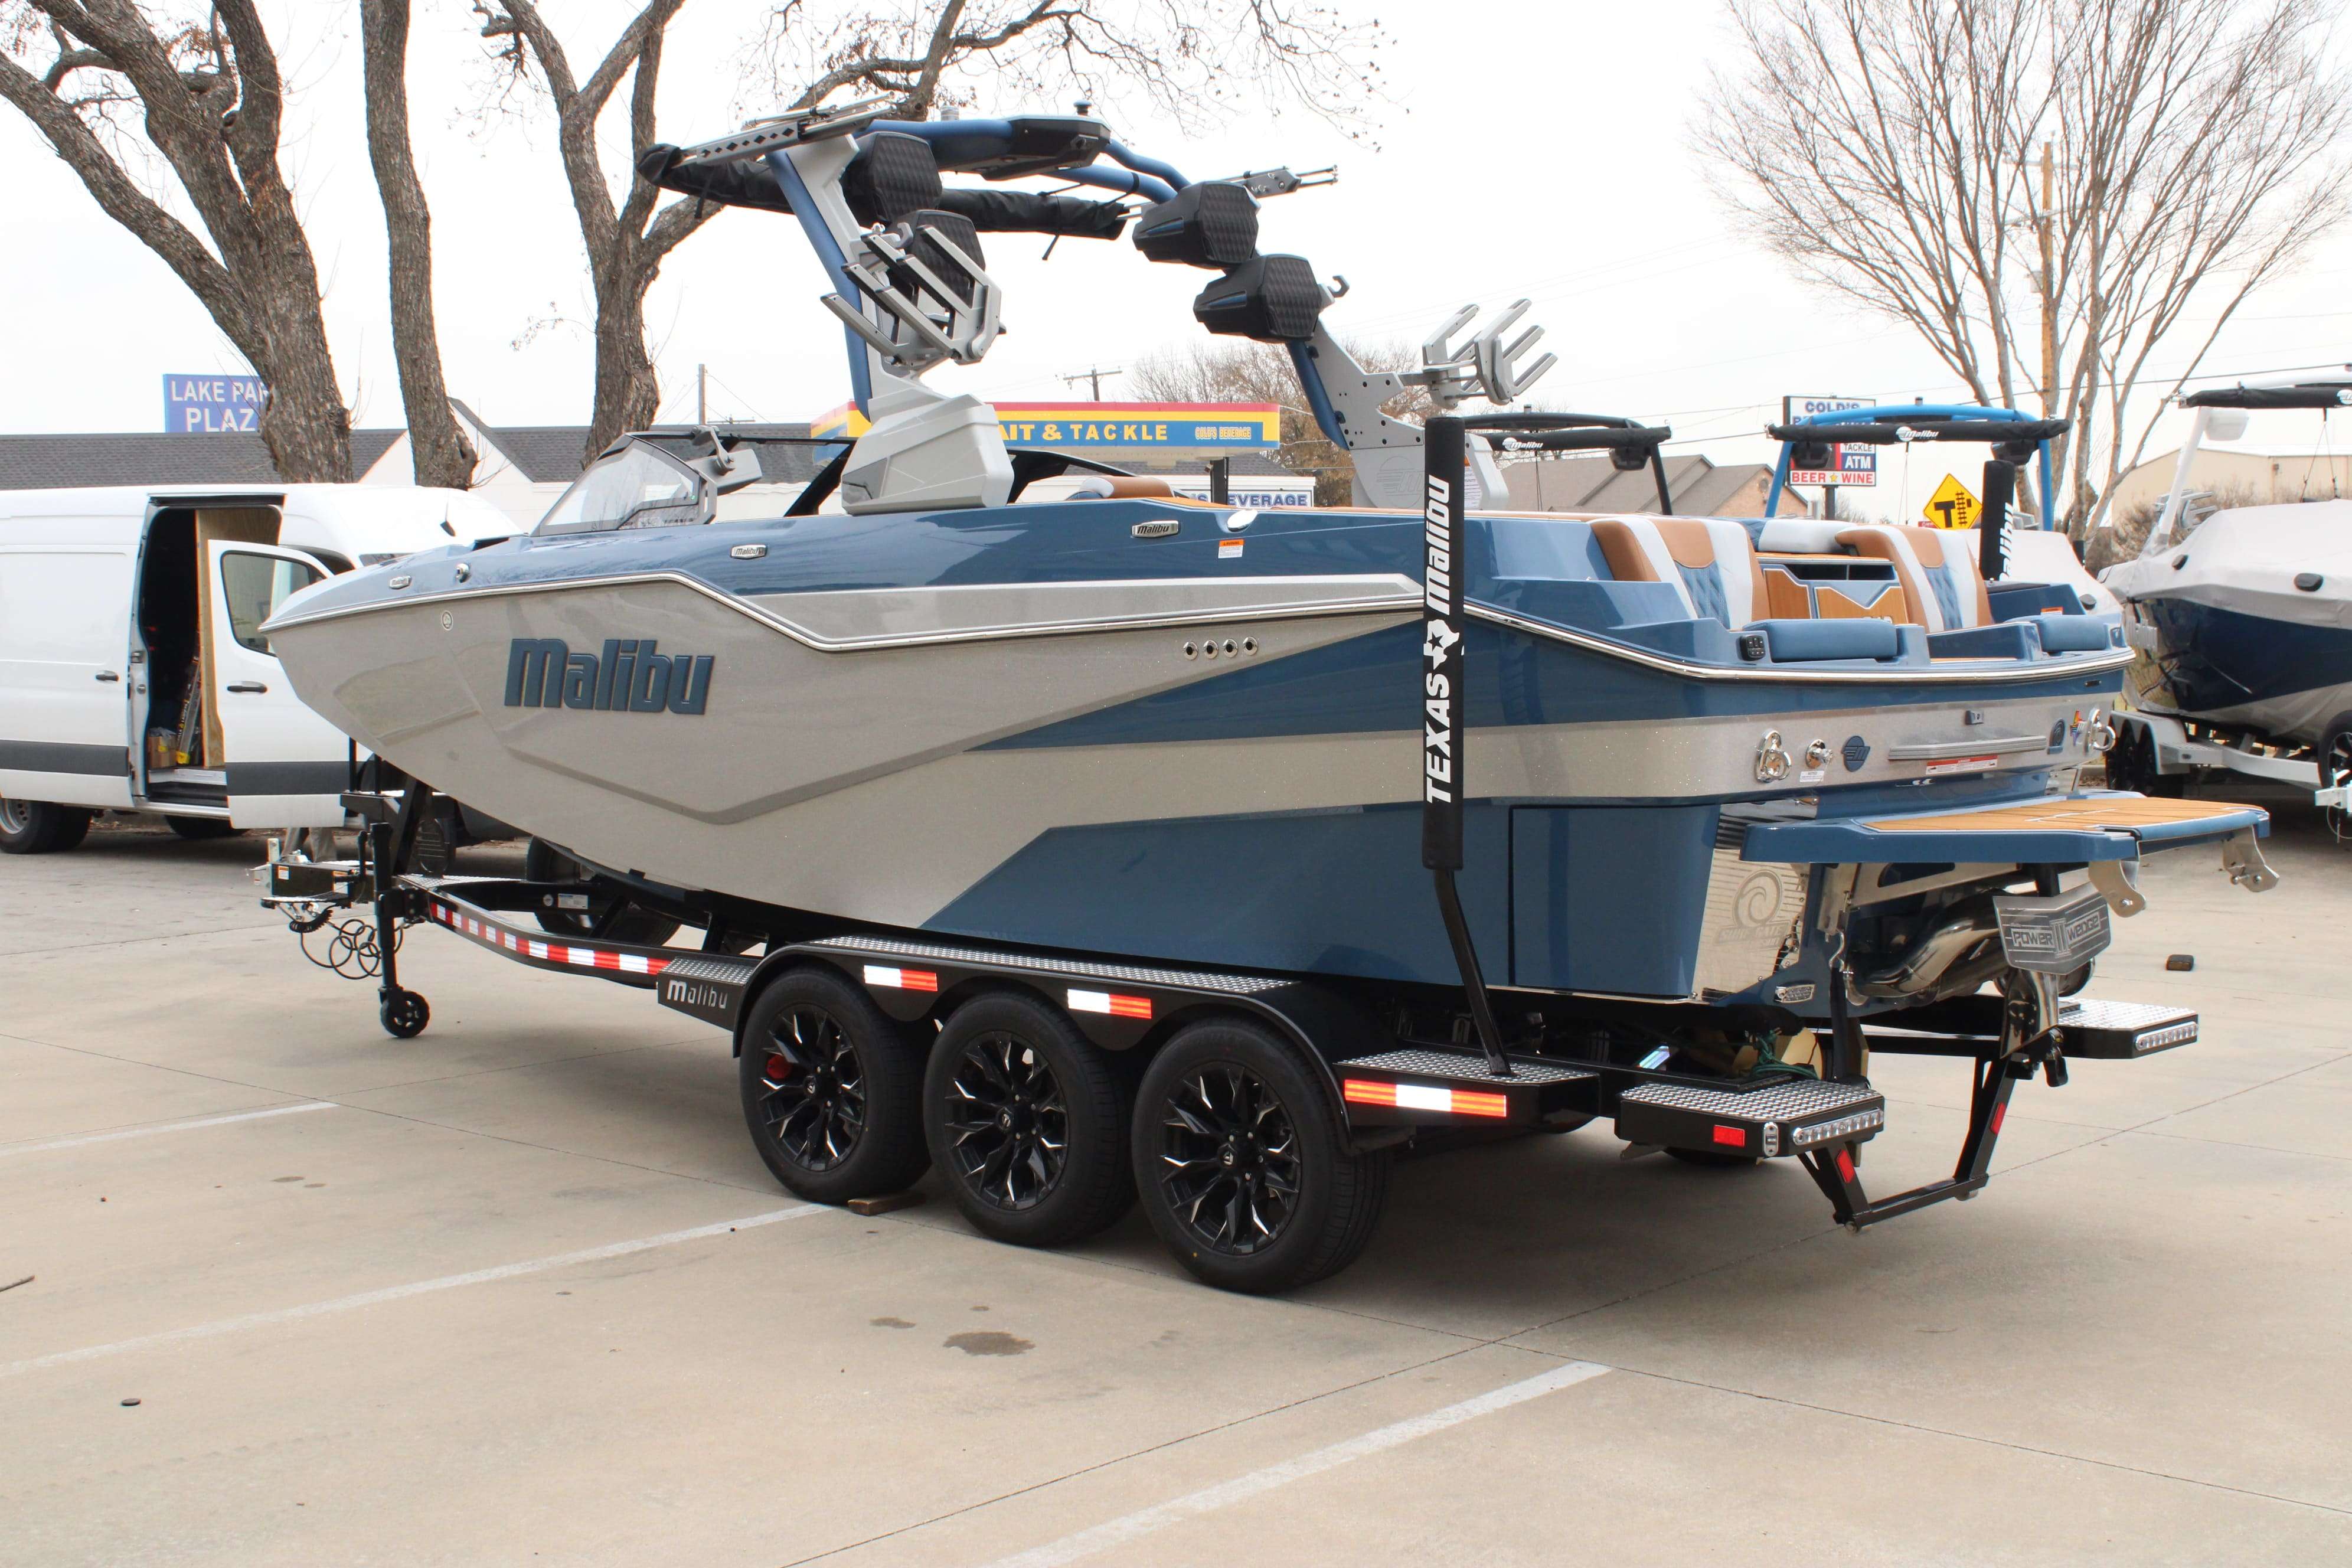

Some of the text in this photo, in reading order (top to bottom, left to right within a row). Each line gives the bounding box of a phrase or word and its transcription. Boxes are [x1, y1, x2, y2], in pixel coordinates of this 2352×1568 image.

[171, 381, 270, 402] LAKE PAR
[185, 407, 256, 432] PLAZ
[998, 424, 1167, 440] AIT & TACKLE
[1195, 427, 1251, 440] COLD'S BEVERAGE
[1844, 443, 1872, 452] TACKLE
[1845, 455, 1871, 469] ATM
[1792, 472, 1873, 484] BEER WINE
[1228, 493, 1309, 507] EVERAGE
[1137, 525, 1170, 534] Malibu
[1426, 474, 1452, 803] TEXAS Malibu
[504, 638, 715, 716] Malibu
[667, 979, 729, 1010] Malibu
